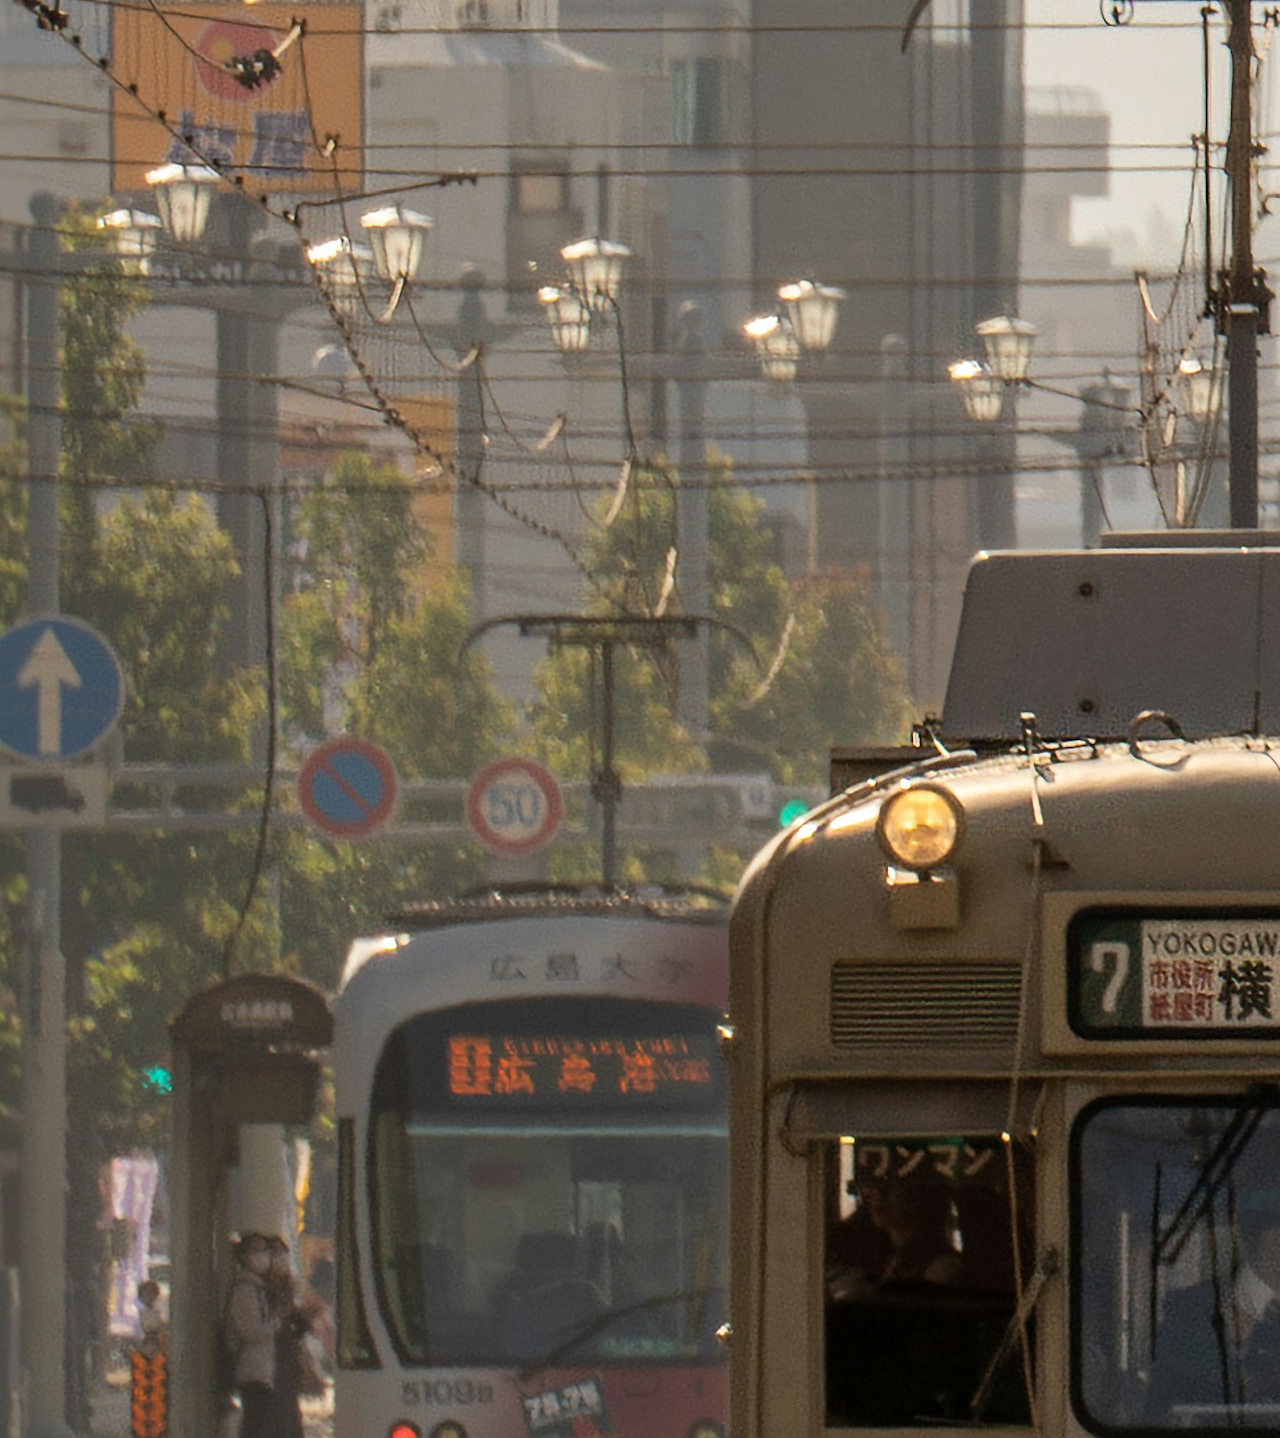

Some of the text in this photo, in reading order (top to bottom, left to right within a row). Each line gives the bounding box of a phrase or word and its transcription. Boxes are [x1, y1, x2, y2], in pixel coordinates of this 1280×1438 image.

[487, 785, 541, 827] 50
[1091, 942, 1131, 1013] 7
[1150, 960, 1215, 989] 市役所
[1150, 992, 1215, 1021] 紙屋町
[858, 1143, 994, 1176] ワンマン
